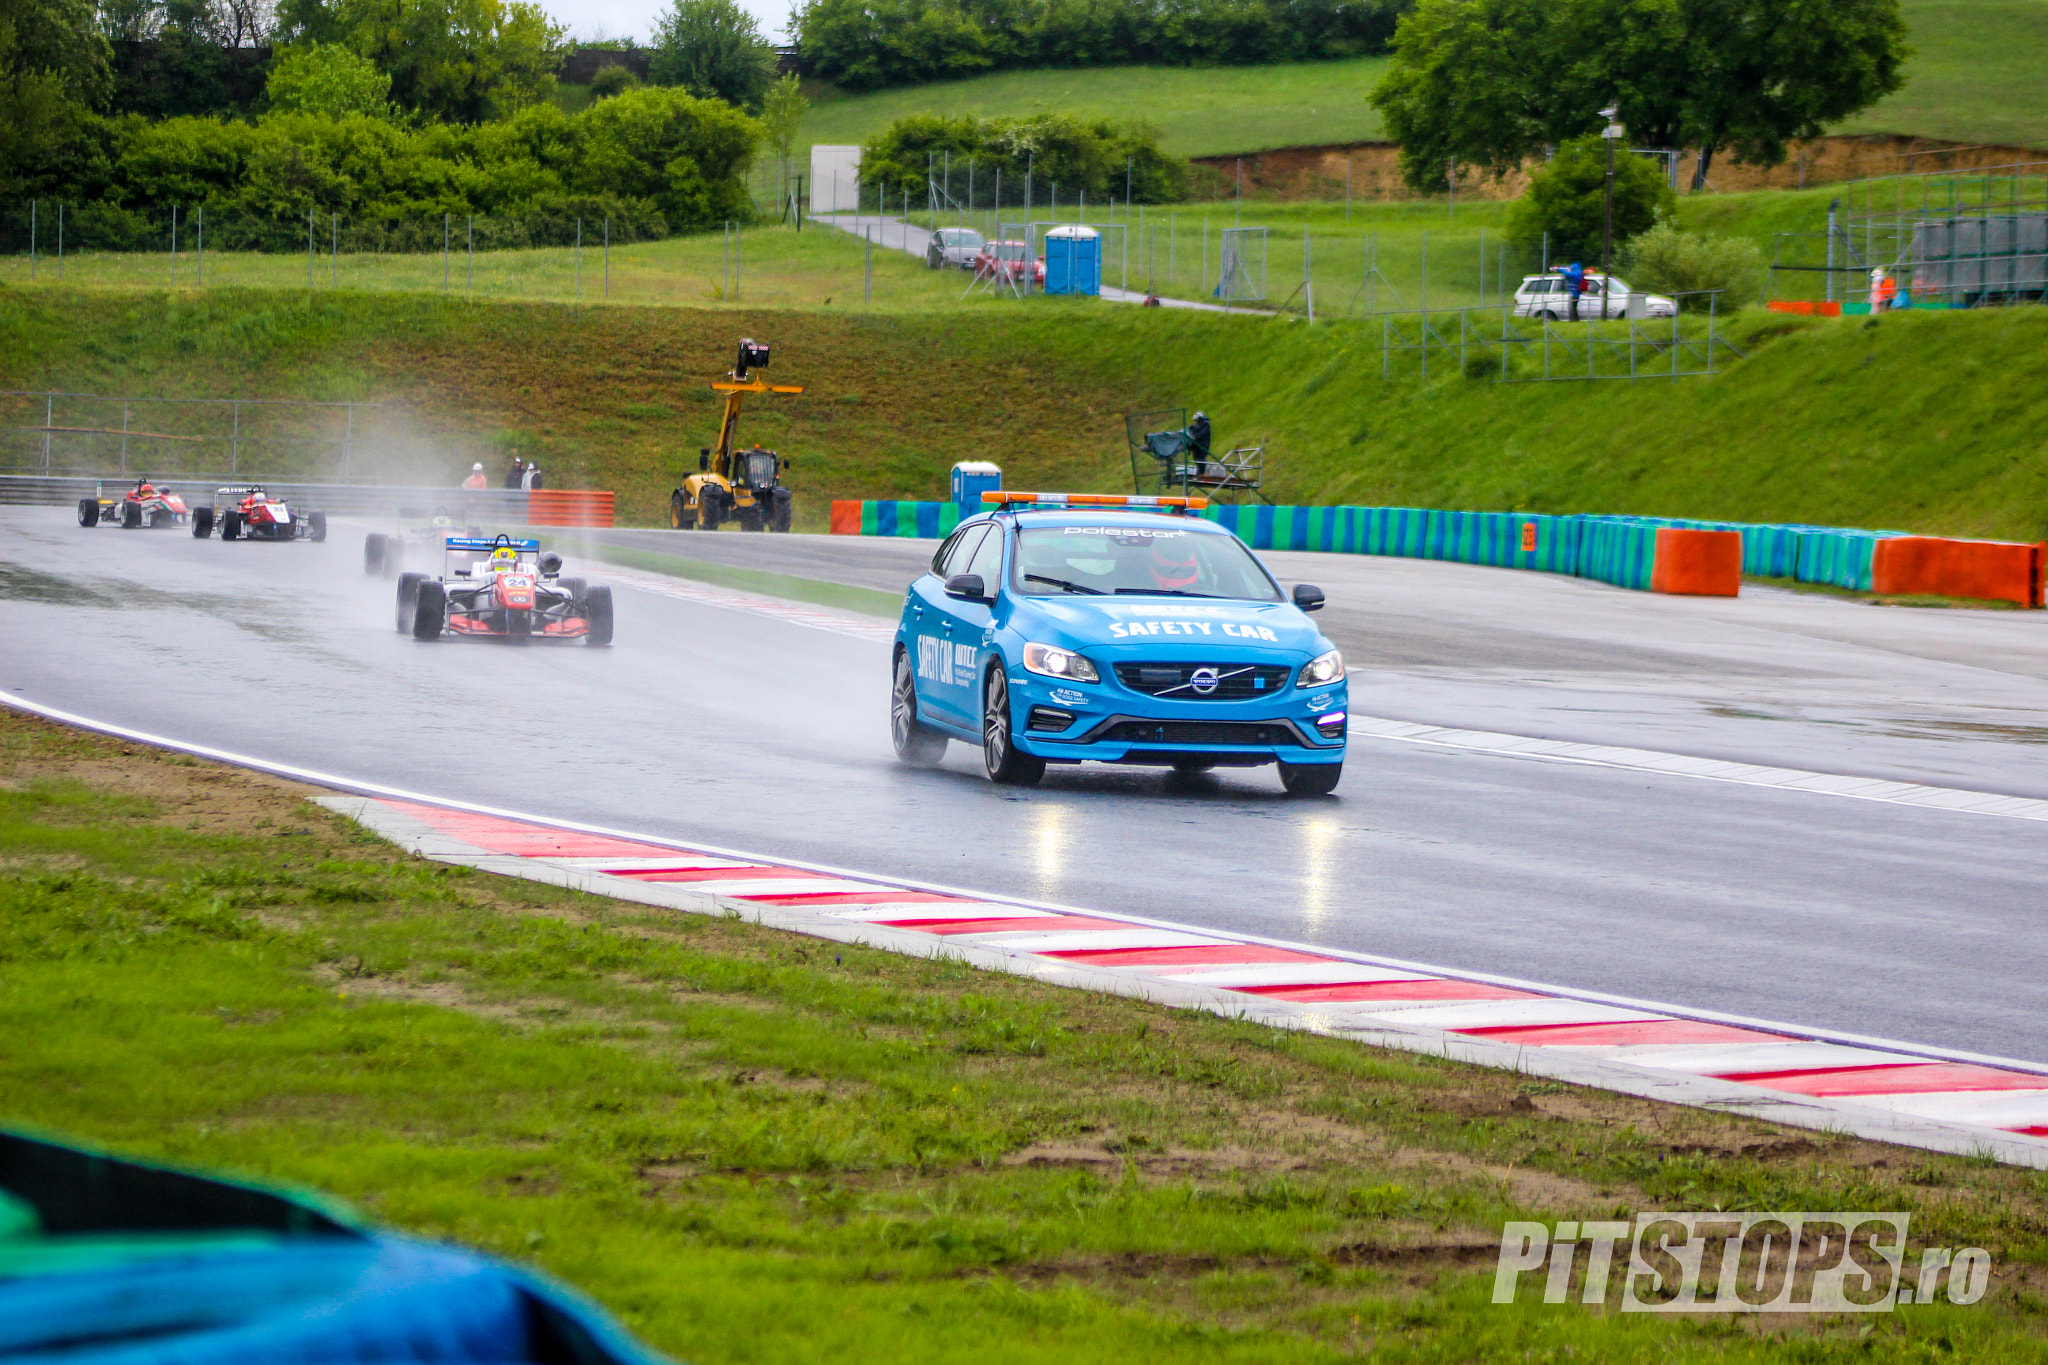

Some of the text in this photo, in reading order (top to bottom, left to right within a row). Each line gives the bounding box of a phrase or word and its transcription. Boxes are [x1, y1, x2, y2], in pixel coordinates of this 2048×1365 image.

[508, 579, 527, 587] 24
[1109, 621, 1279, 643] SAFETY CAR
[917, 634, 953, 685] SAFETY CAR
[1064, 689, 1083, 698] ACTION
